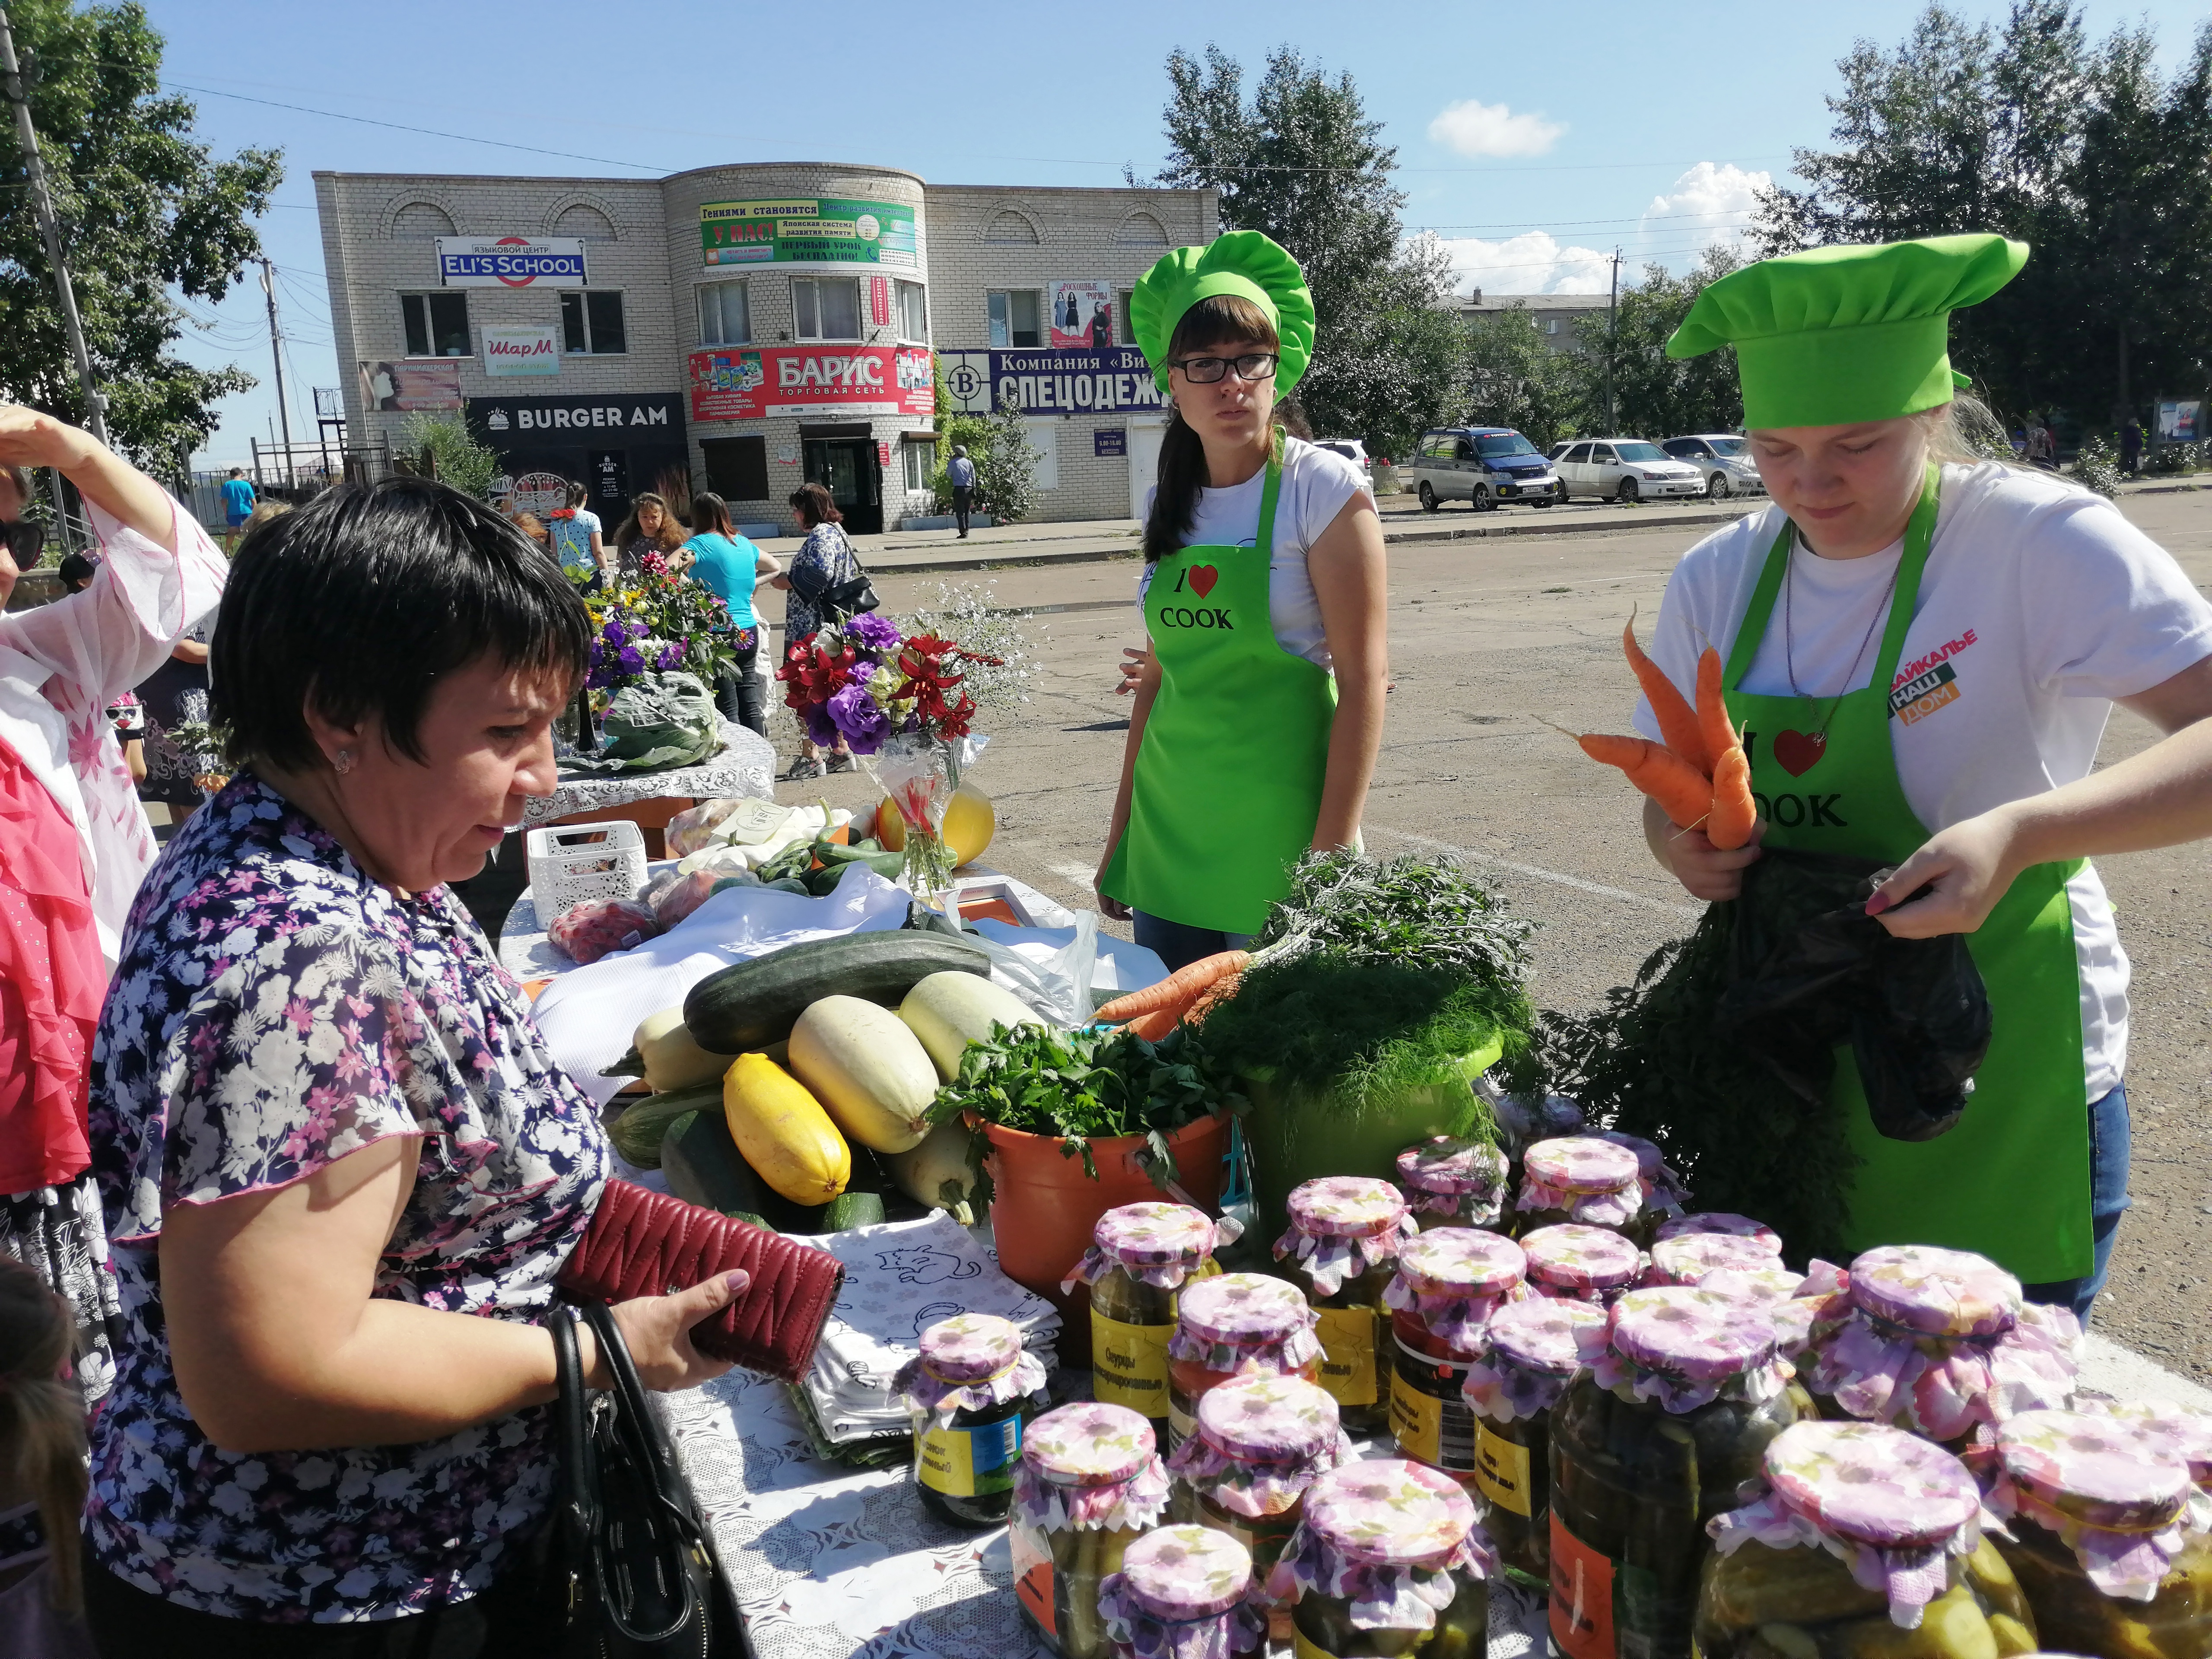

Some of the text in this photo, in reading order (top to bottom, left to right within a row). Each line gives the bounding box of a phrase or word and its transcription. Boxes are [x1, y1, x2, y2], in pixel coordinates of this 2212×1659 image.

[702, 206, 817, 219] Гениями становятся
[823, 203, 847, 212] Центр
[850, 205, 881, 213] развития
[713, 222, 774, 245] У НАС!
[474, 245, 549, 255] ЯЗЫКОВОЙ ЦЕНТР
[782, 239, 861, 251] ПЕРВЫЙ УРОК
[497, 256, 582, 274] SCHOOL
[792, 251, 858, 261] БЕСПЛАТНО!
[1063, 283, 1098, 291] РОСКОШНЫЕ
[1086, 292, 1107, 300] ФОРМЫ
[1000, 352, 1150, 371] Компания «Ви
[776, 356, 884, 388] БАРИС
[779, 387, 885, 396] ТОРГОВАЯ СЕТЬ
[518, 406, 667, 429] BURGER AM
[1173, 567, 1187, 593] I
[1160, 607, 1234, 630] COOK
[1892, 671, 1942, 708] НАШ
[1904, 686, 1952, 725] ДОМ
